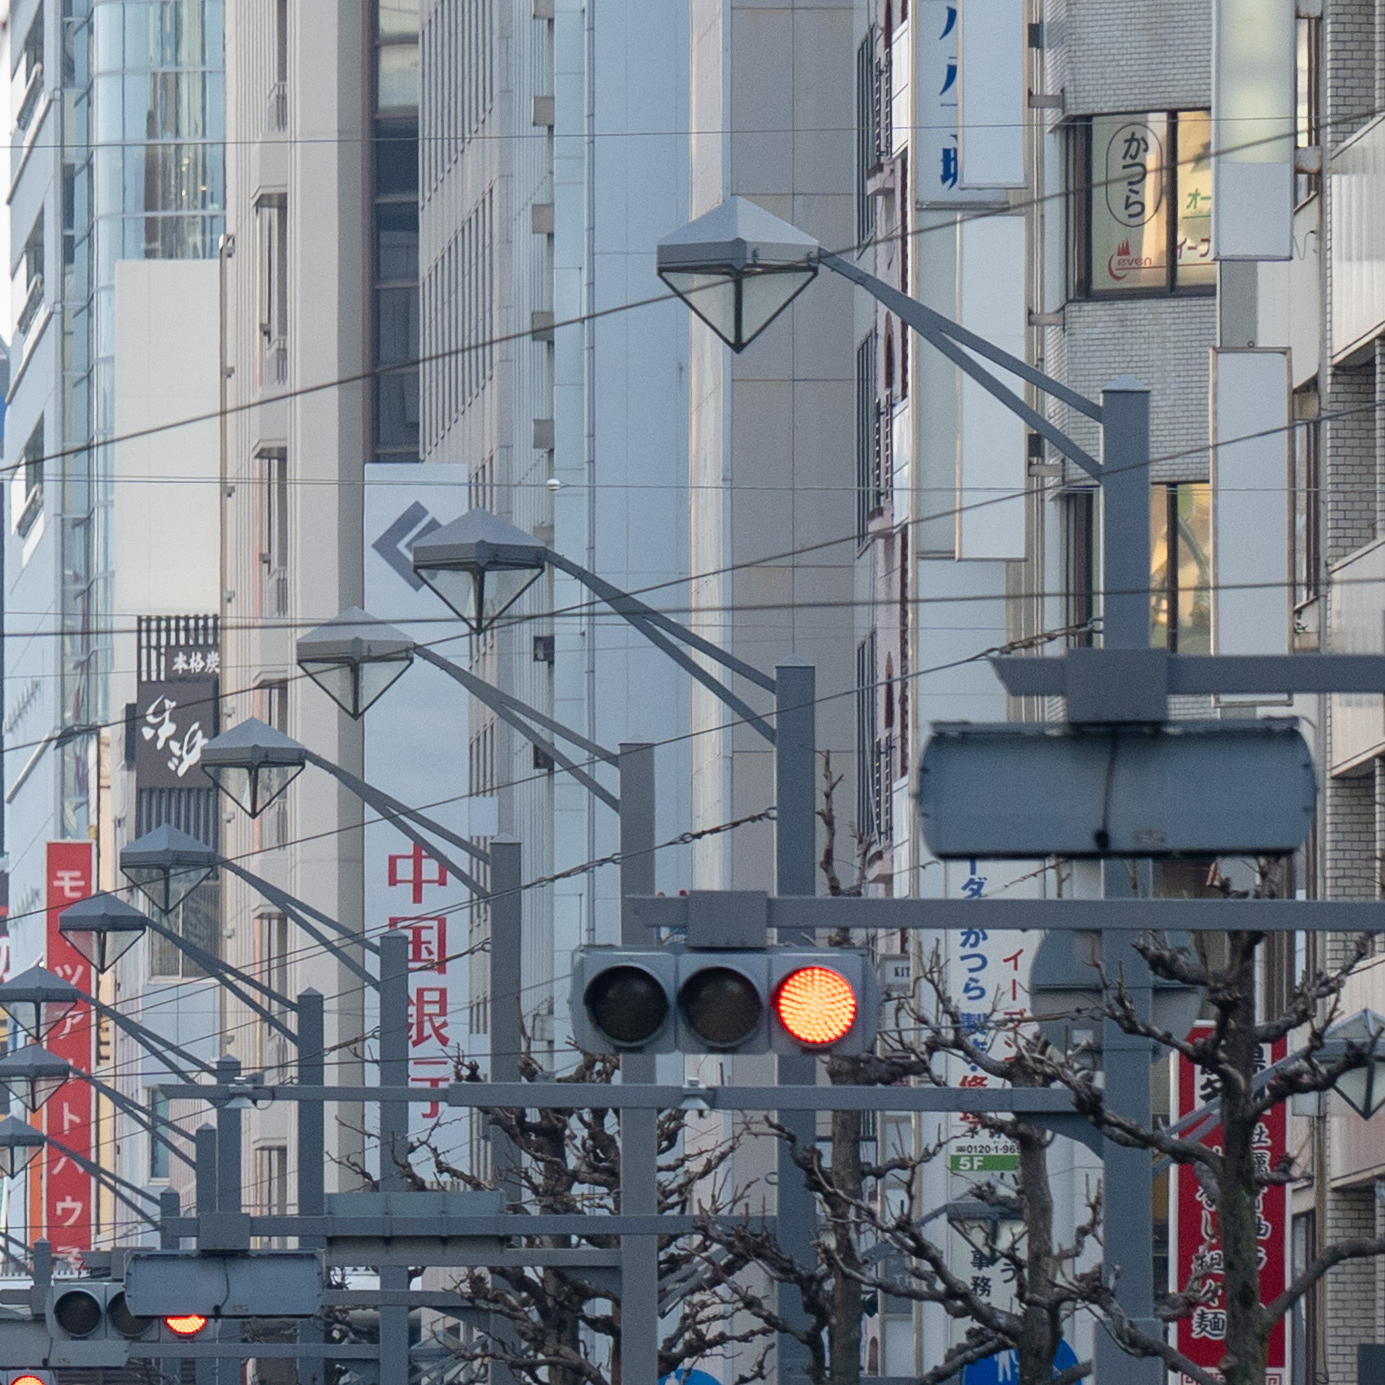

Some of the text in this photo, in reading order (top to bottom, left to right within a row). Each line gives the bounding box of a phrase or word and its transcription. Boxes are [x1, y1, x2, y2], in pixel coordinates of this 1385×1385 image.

[1121, 131, 1149, 219] かつら
[958, 1156, 984, 1171] 5F
[970, 1250, 992, 1300] 事務
